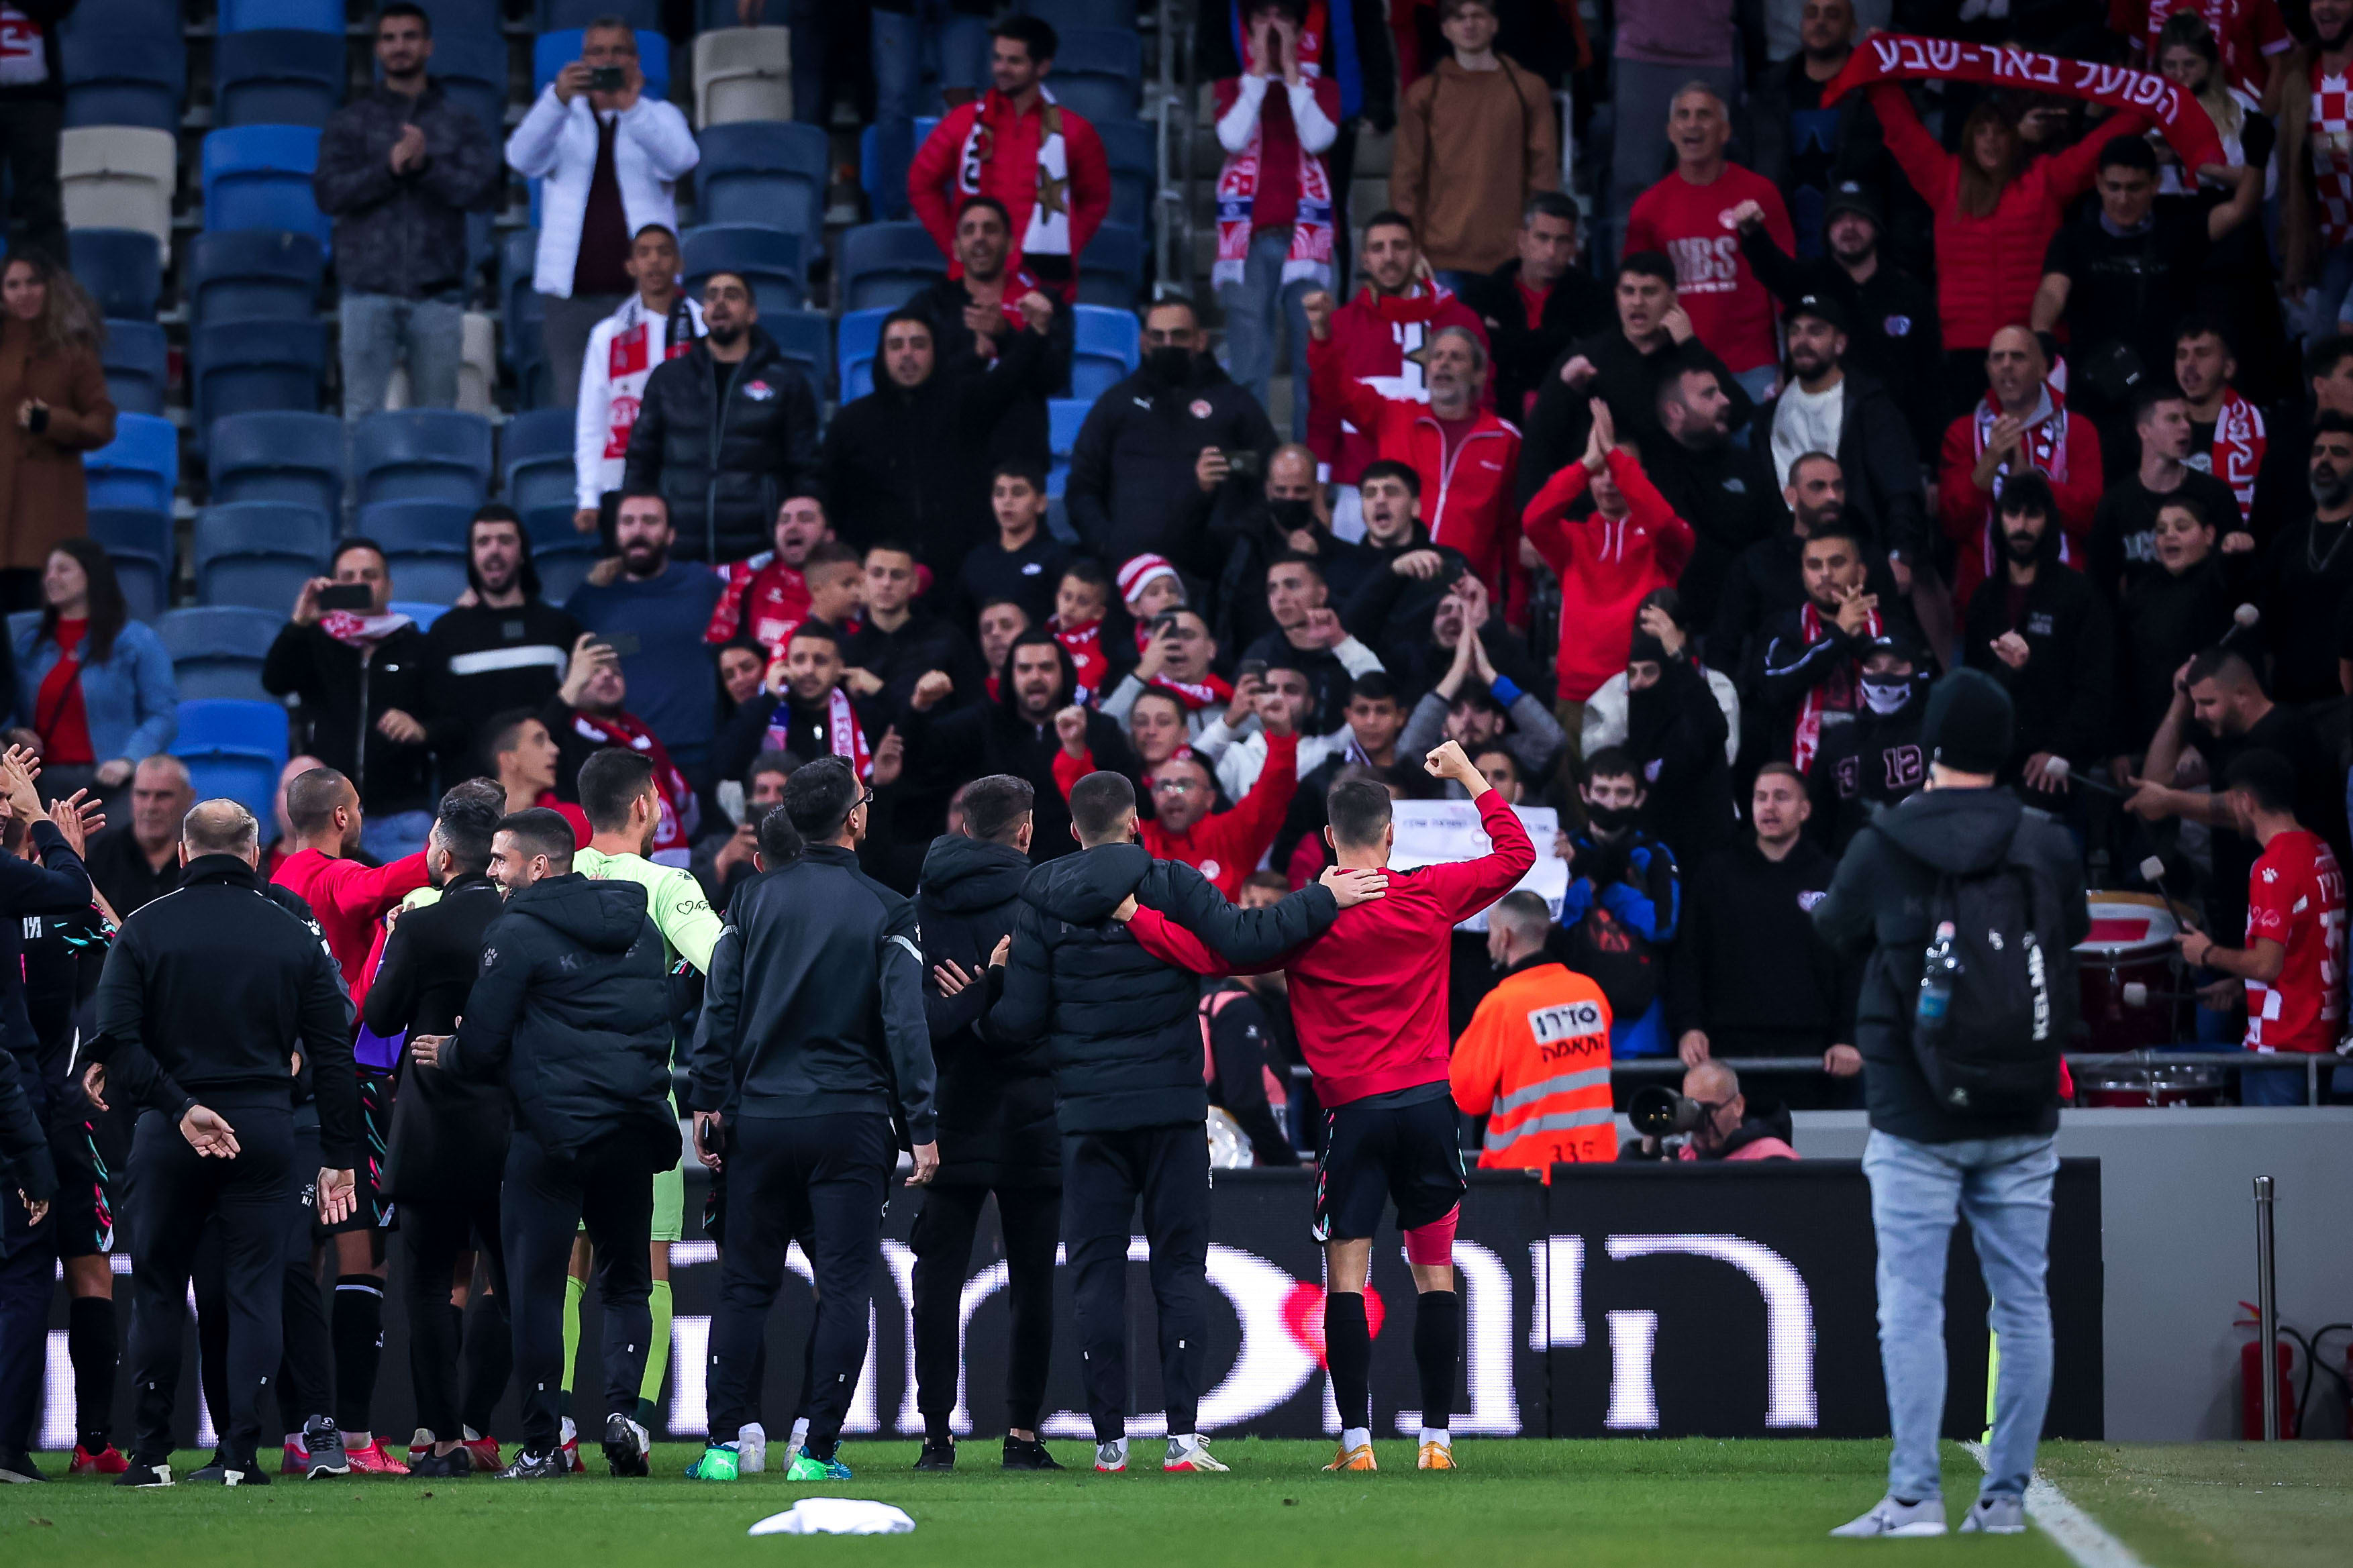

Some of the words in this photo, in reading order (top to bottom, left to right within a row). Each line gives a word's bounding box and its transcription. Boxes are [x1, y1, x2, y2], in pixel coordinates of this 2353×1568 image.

[1872, 39, 2060, 83] באר-שבע
[2075, 60, 2179, 125] הפועל
[1883, 745, 1923, 790] 12
[1536, 1006, 1597, 1036] סדרן
[666, 1233, 1819, 1436] הינמה
